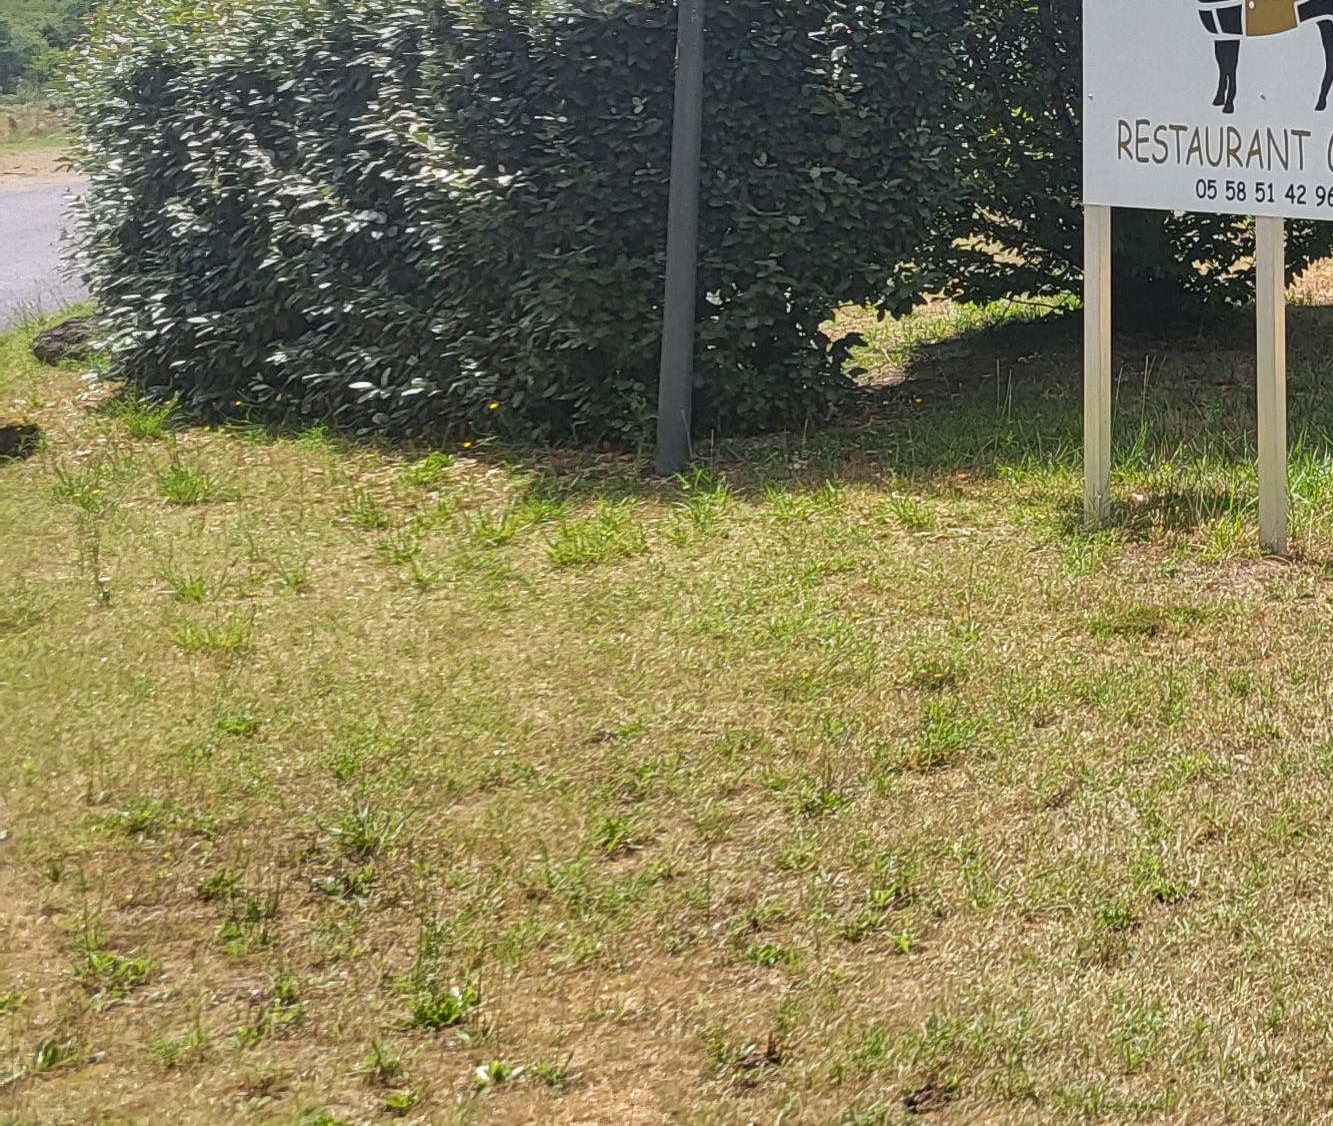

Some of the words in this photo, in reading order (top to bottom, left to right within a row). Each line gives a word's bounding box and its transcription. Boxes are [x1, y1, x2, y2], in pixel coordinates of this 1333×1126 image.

[1118, 119, 1311, 171] RESTAURANT
[1195, 179, 1218, 200] 05
[1225, 181, 1247, 202] 58
[1255, 182, 1275, 204] 51
[1284, 184, 1307, 205] 42
